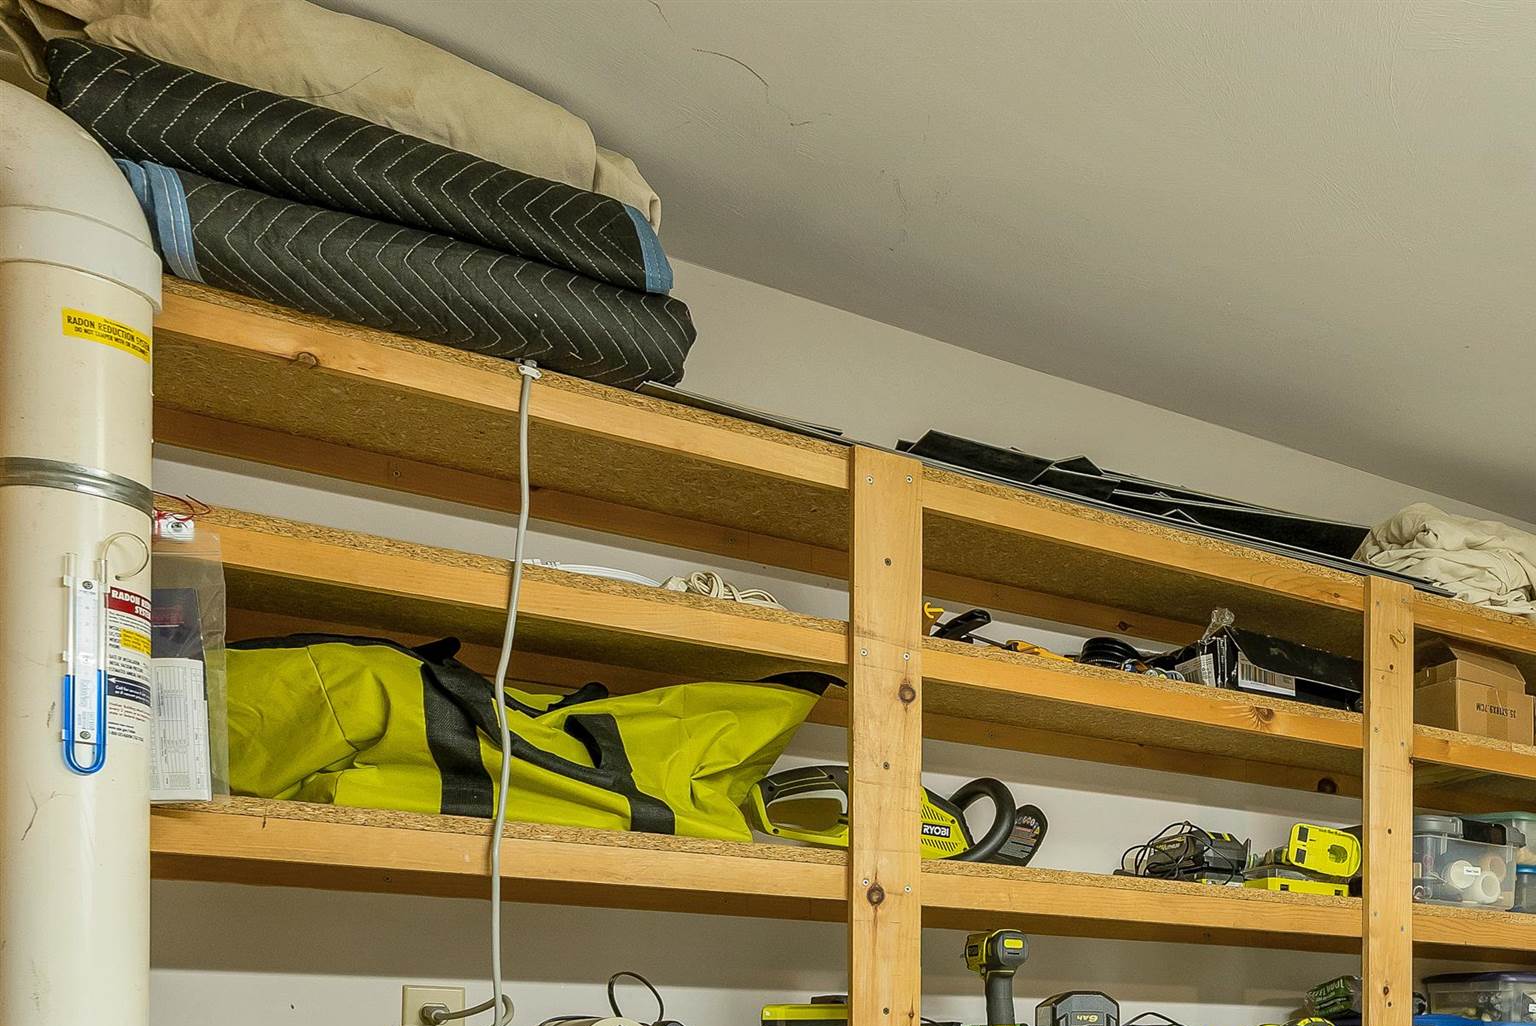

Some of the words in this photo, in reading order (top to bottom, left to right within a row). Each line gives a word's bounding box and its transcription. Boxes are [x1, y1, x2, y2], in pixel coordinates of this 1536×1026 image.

[67, 315, 95, 328] RADON
[98, 322, 134, 342] REDUCTION
[111, 589, 141, 605] RADON
[923, 824, 949, 837] RYOBI
